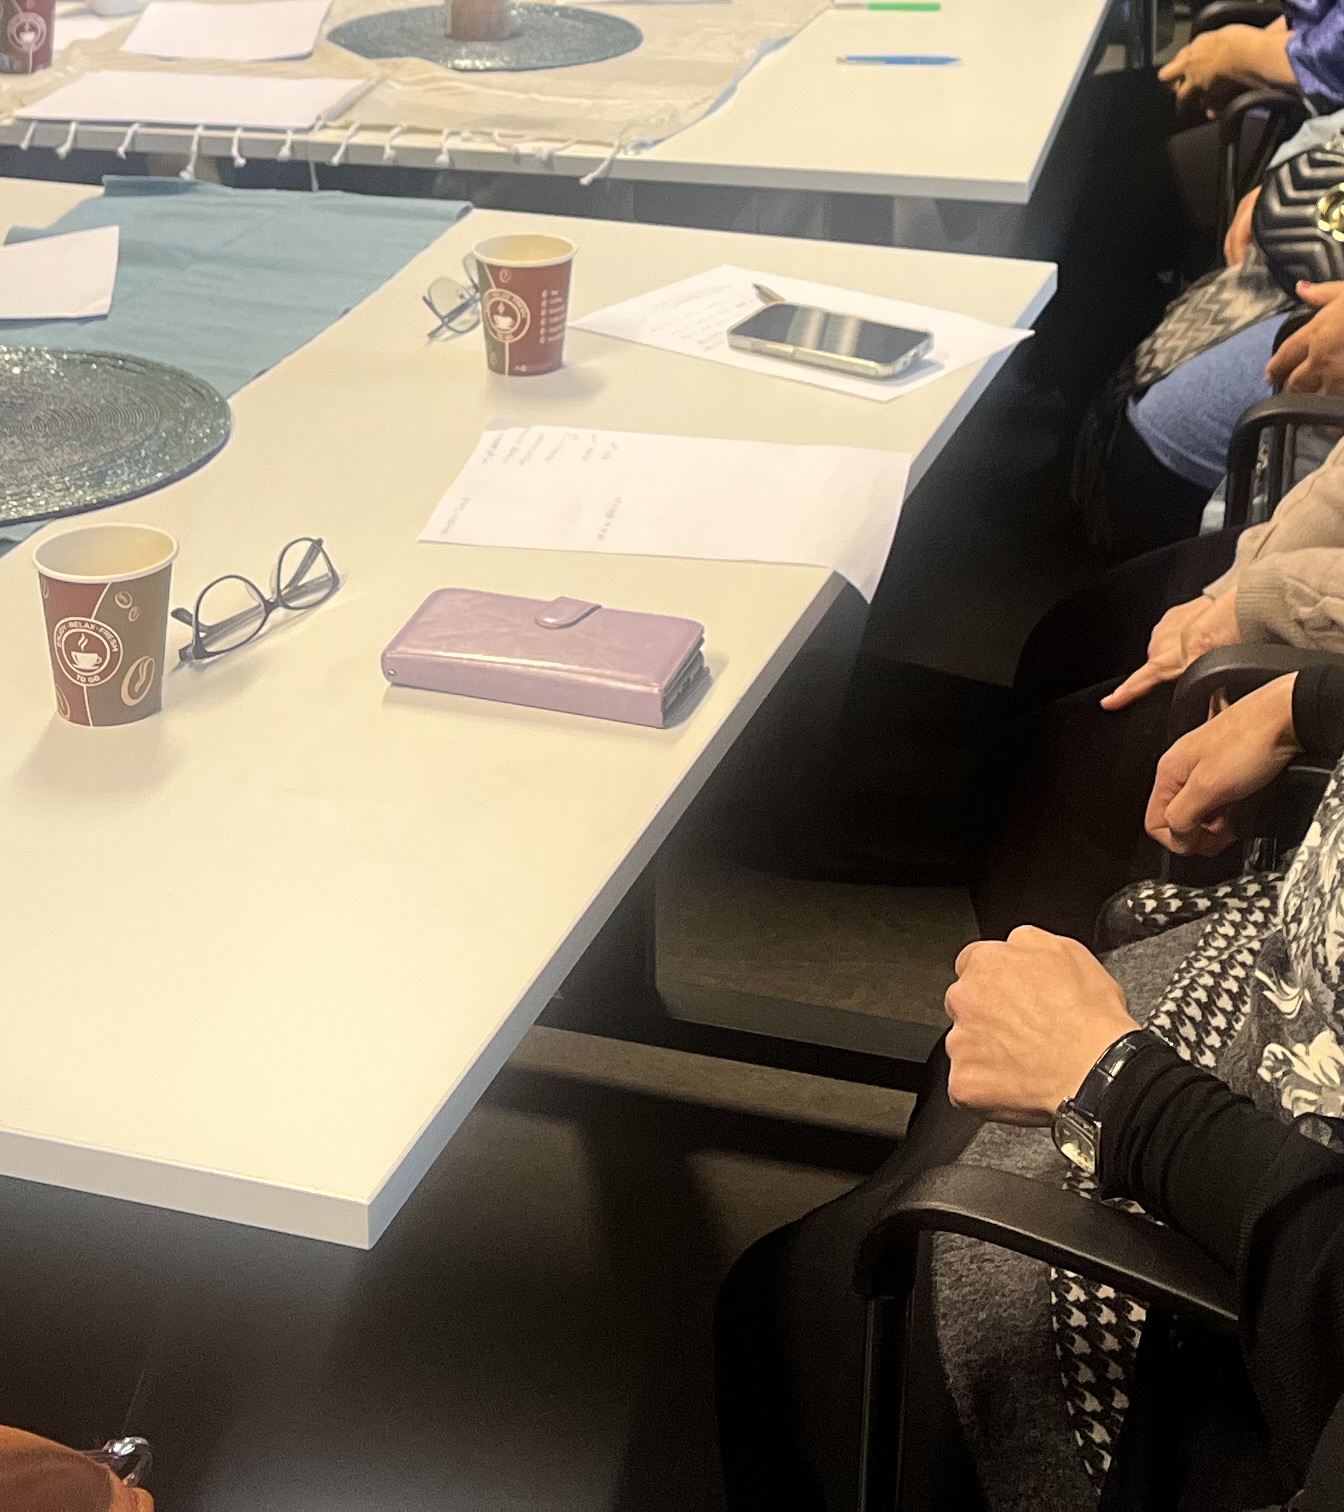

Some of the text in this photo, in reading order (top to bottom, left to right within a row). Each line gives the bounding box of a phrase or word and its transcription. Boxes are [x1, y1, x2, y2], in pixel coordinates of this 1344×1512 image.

[68, 621, 96, 630] RELAX
[98, 627, 119, 653] FRESH
[76, 674, 101, 684] TO GO
